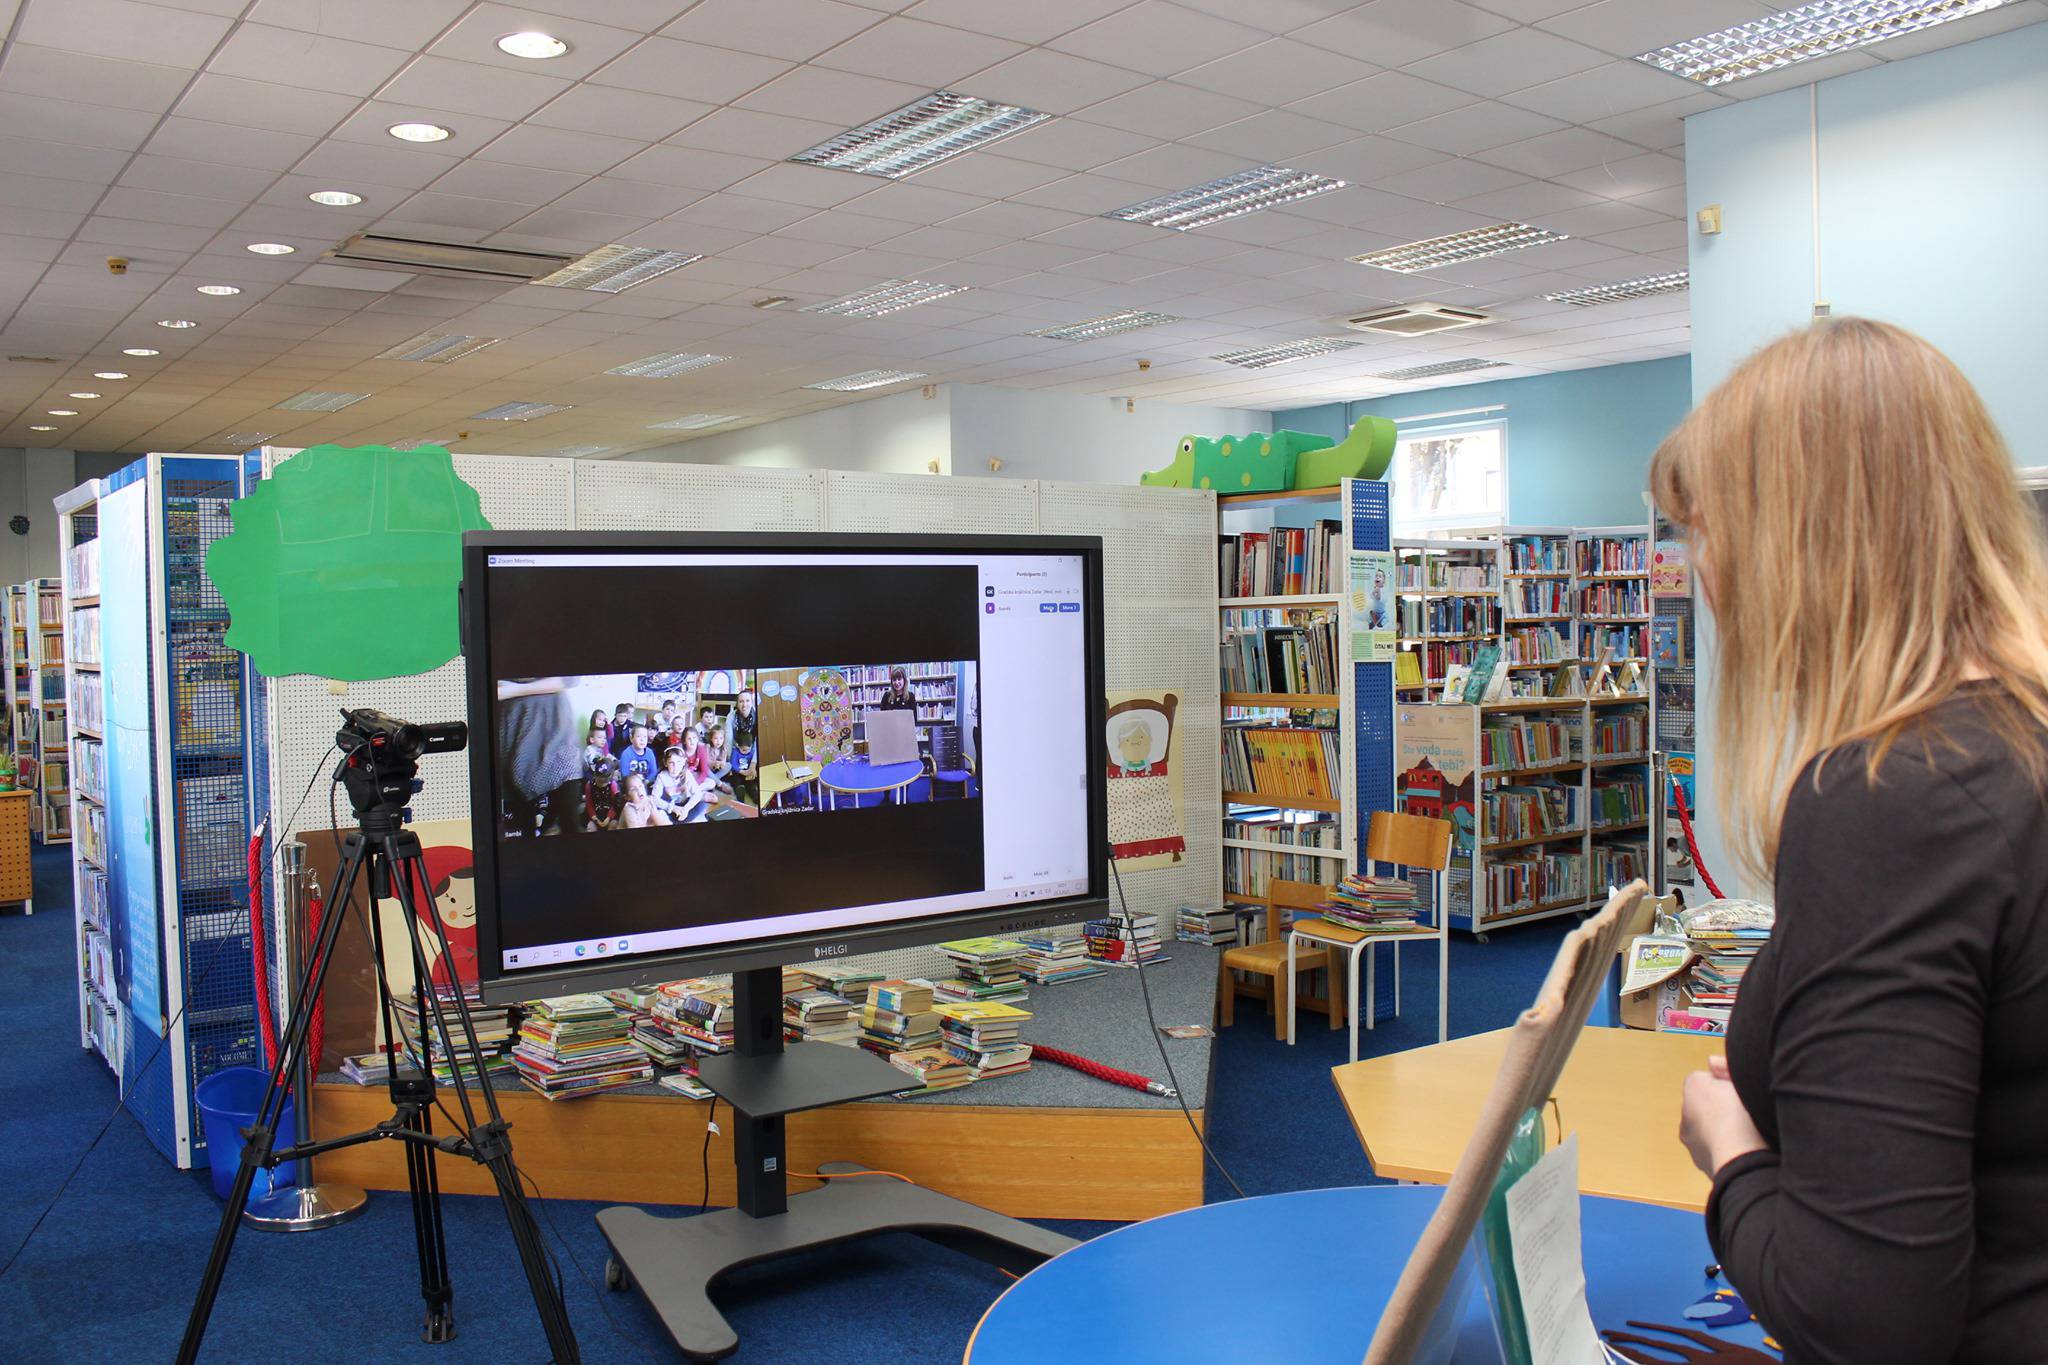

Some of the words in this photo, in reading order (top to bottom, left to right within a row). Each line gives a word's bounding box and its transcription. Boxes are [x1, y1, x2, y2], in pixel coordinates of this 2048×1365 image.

[1417, 744, 1440, 755] voda
[1438, 759, 1465, 771] tebi?
[821, 944, 848, 956] HELGI
